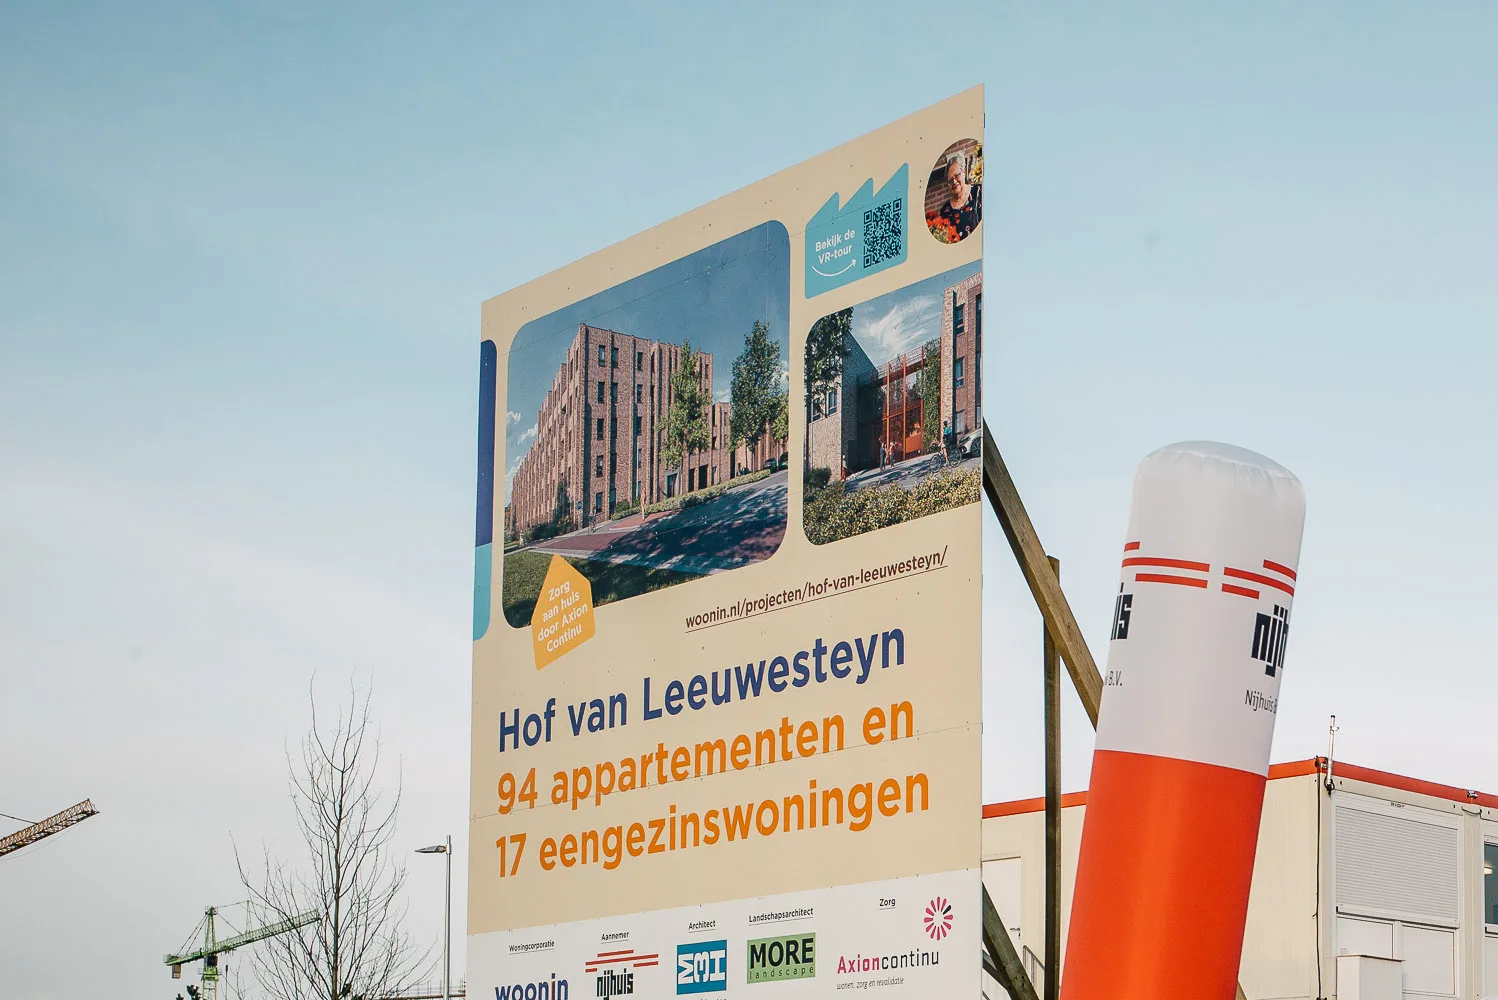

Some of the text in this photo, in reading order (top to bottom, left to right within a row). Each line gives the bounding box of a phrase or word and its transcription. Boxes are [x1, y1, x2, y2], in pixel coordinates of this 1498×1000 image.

[815, 229, 855, 252] Bekijk de
[818, 245, 852, 264] VR-tour
[548, 580, 570, 602] Zorg
[686, 545, 948, 629] woonin.nl/projecten/hof-van-leeuwesteyn/
[543, 591, 580, 622] aan huis
[537, 603, 588, 641] door Axion
[547, 624, 582, 652] Continu
[499, 628, 905, 753] Hof van Leeuwesteyn
[1245, 689, 1273, 713] Nijhuis
[498, 700, 914, 815] 94 appartementen en
[495, 771, 929, 878] 17 eengezinswoningen
[879, 898, 896, 908] Zorg
[689, 920, 716, 930] Architect
[749, 907, 813, 923] Landschapsarchitect
[509, 940, 555, 953] Woningcorporatie
[601, 931, 630, 941] Aannemer
[750, 938, 813, 969] MORE
[837, 948, 939, 974] Axioncontinu
[750, 966, 814, 980] landscape
[836, 981, 855, 990] wonen,
[856, 981, 868, 989] zorg
[876, 977, 904, 987] revalidatie
